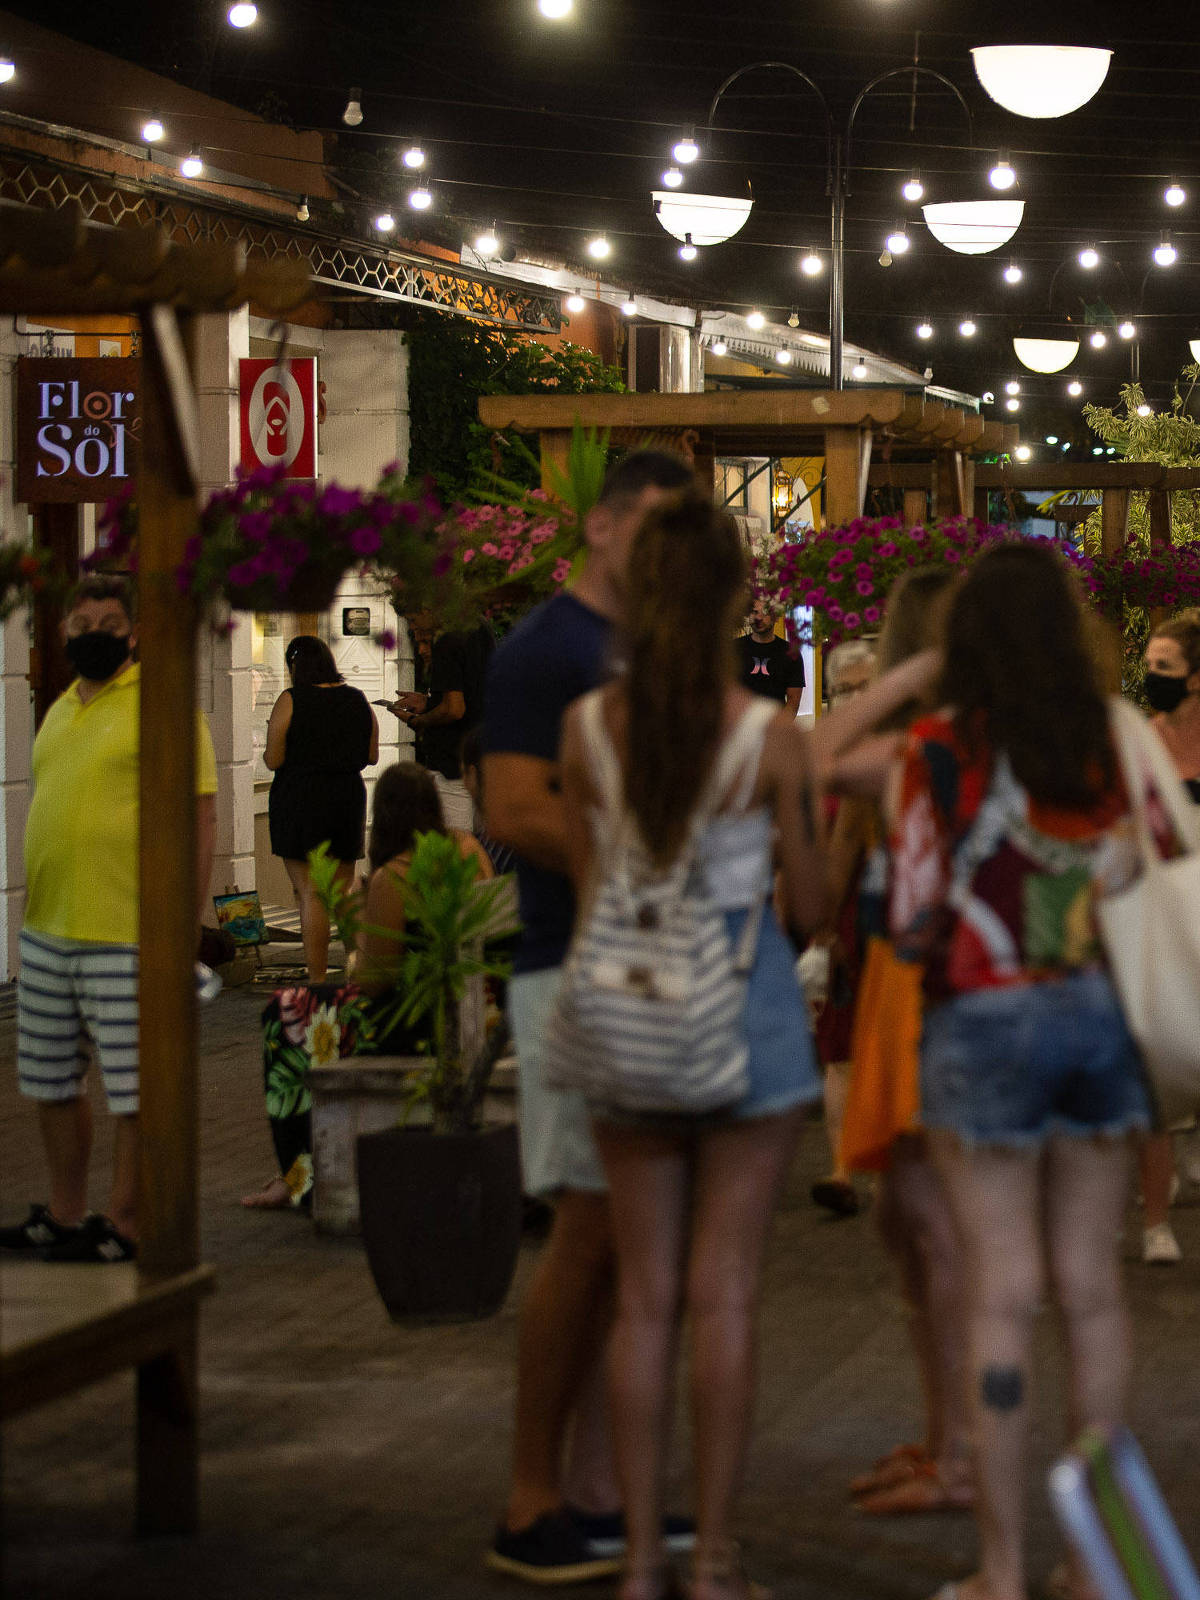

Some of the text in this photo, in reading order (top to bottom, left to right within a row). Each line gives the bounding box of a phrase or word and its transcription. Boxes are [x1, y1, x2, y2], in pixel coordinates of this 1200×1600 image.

[36, 380, 135, 420] Flor
[83, 423, 100, 437] do
[36, 423, 129, 478] Sol
